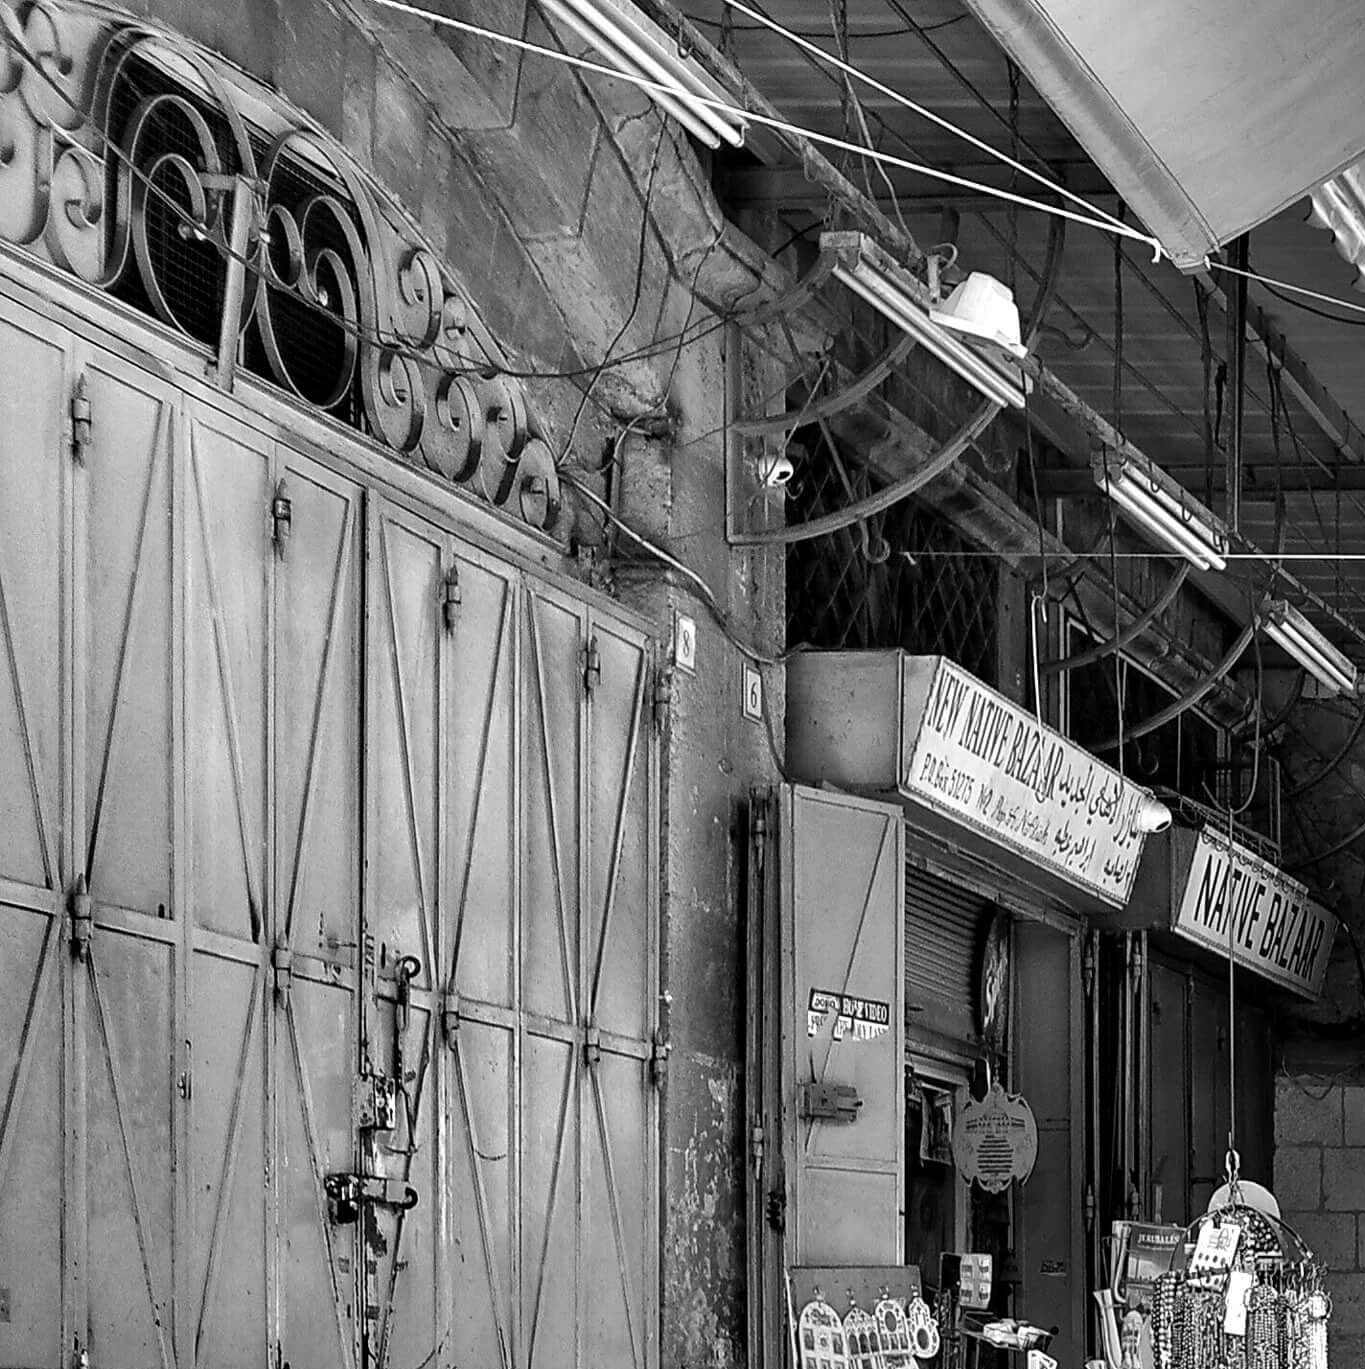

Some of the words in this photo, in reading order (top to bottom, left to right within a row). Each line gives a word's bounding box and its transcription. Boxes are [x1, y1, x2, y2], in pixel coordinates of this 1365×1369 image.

[683, 630, 690, 657] 8
[750, 682, 758, 709] 6
[927, 668, 970, 740] NEW
[958, 691, 1014, 768] NATIVE
[1004, 720, 1064, 801] BAZAAR
[1194, 854, 1267, 950] NATIVE
[1258, 892, 1326, 983] BAZAAR
